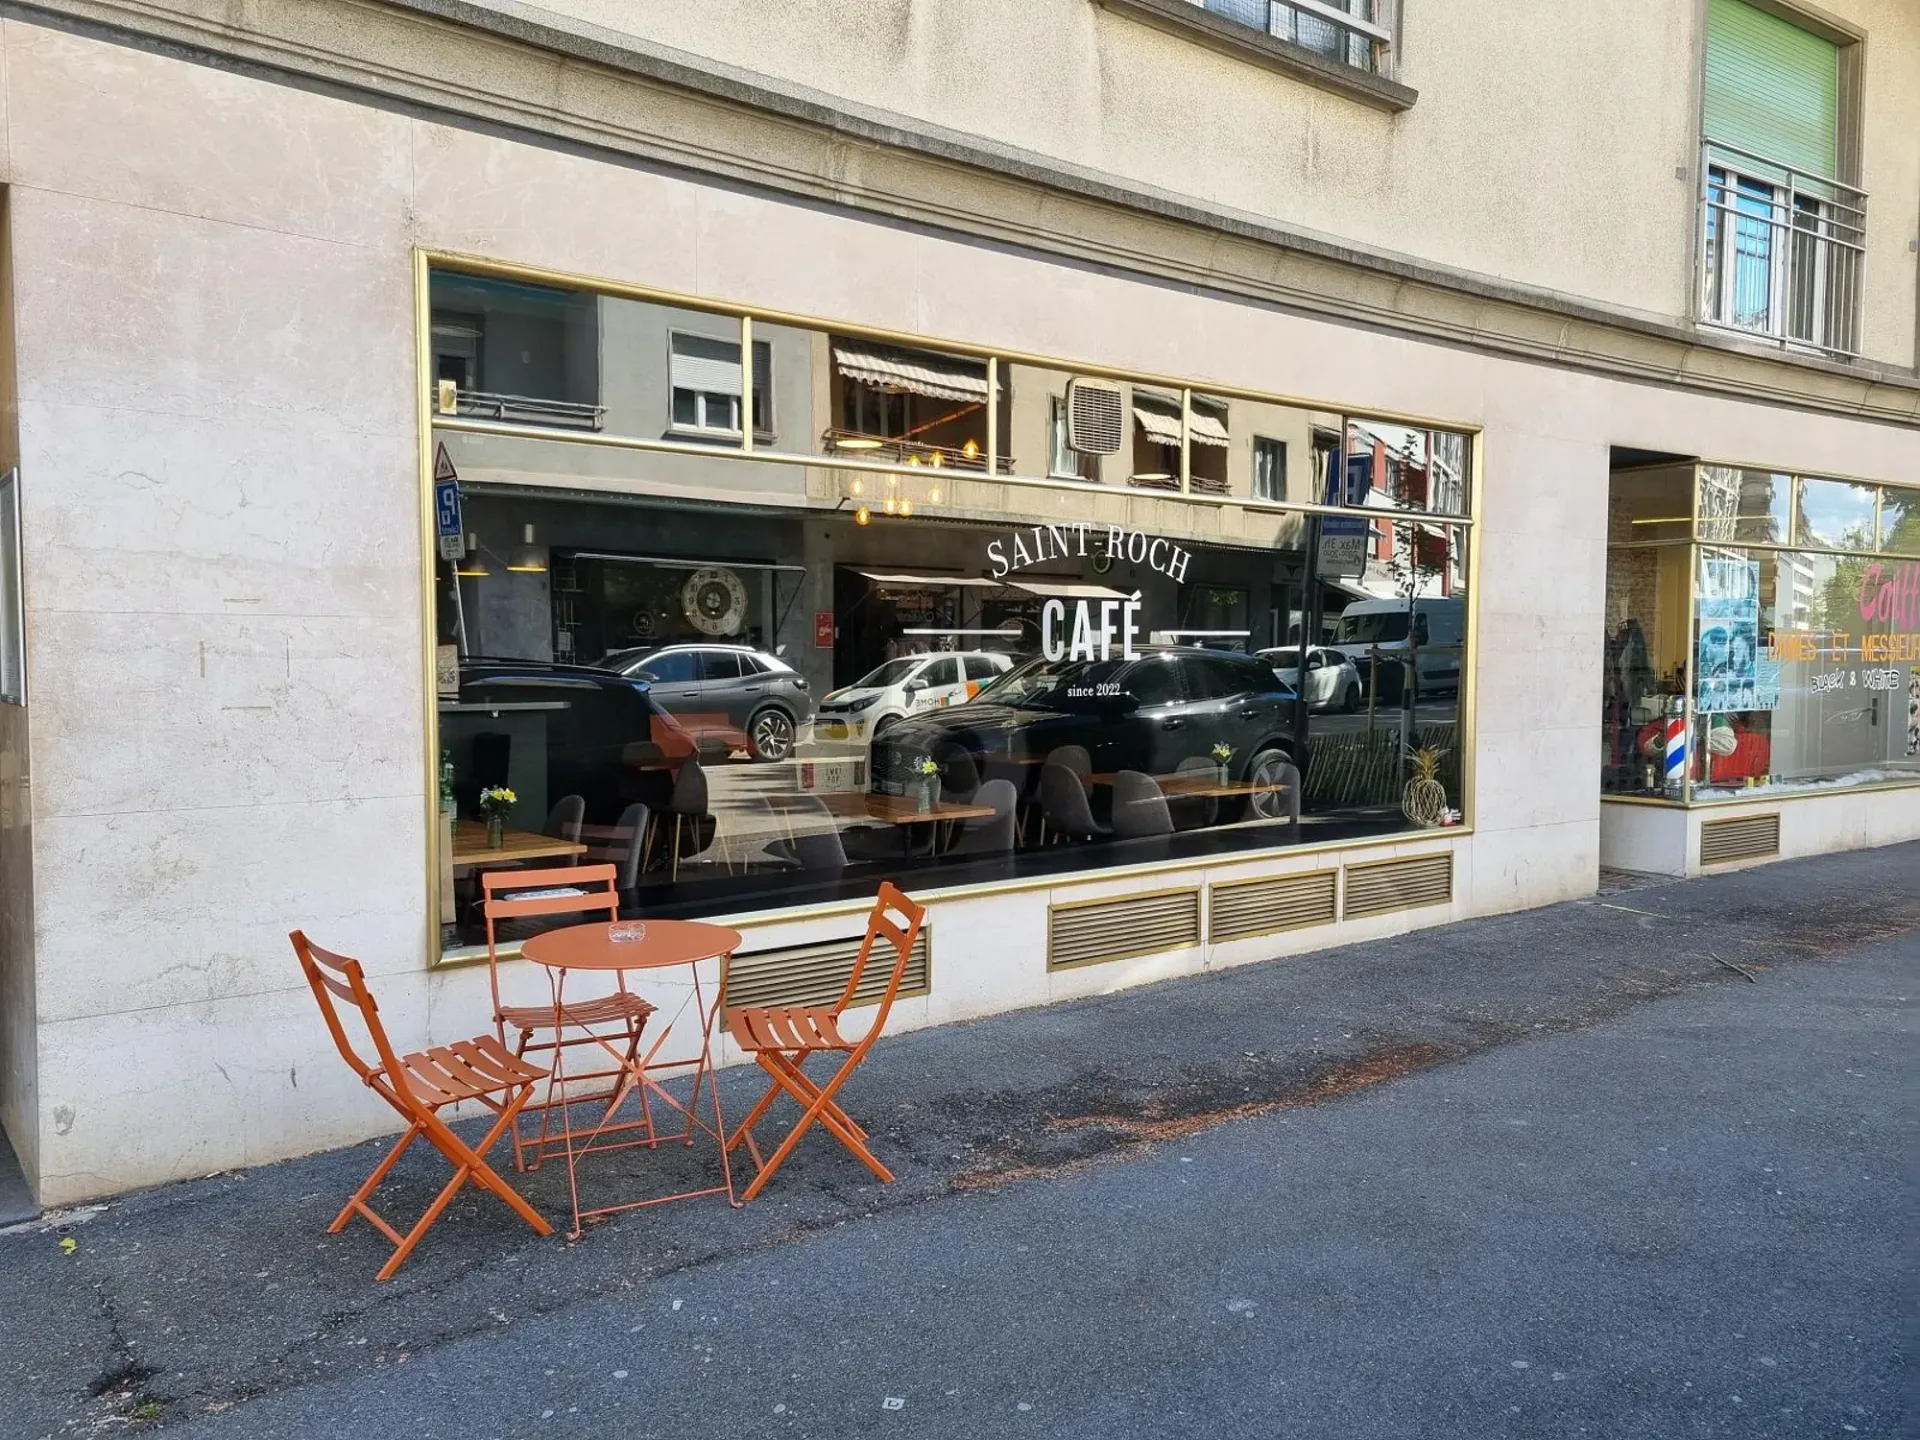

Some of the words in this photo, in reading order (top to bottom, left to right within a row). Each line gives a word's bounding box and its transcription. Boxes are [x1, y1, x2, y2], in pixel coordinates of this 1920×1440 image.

[987, 522, 1192, 584] SAINT-ROCH
[1042, 589, 1142, 662] CAFÉ
[1860, 563, 1920, 630] Coiff
[1067, 684, 1094, 697] since
[1096, 683, 1120, 696] 2022
[1811, 667, 1846, 694] BLACK
[1862, 668, 1900, 690] WHITE
